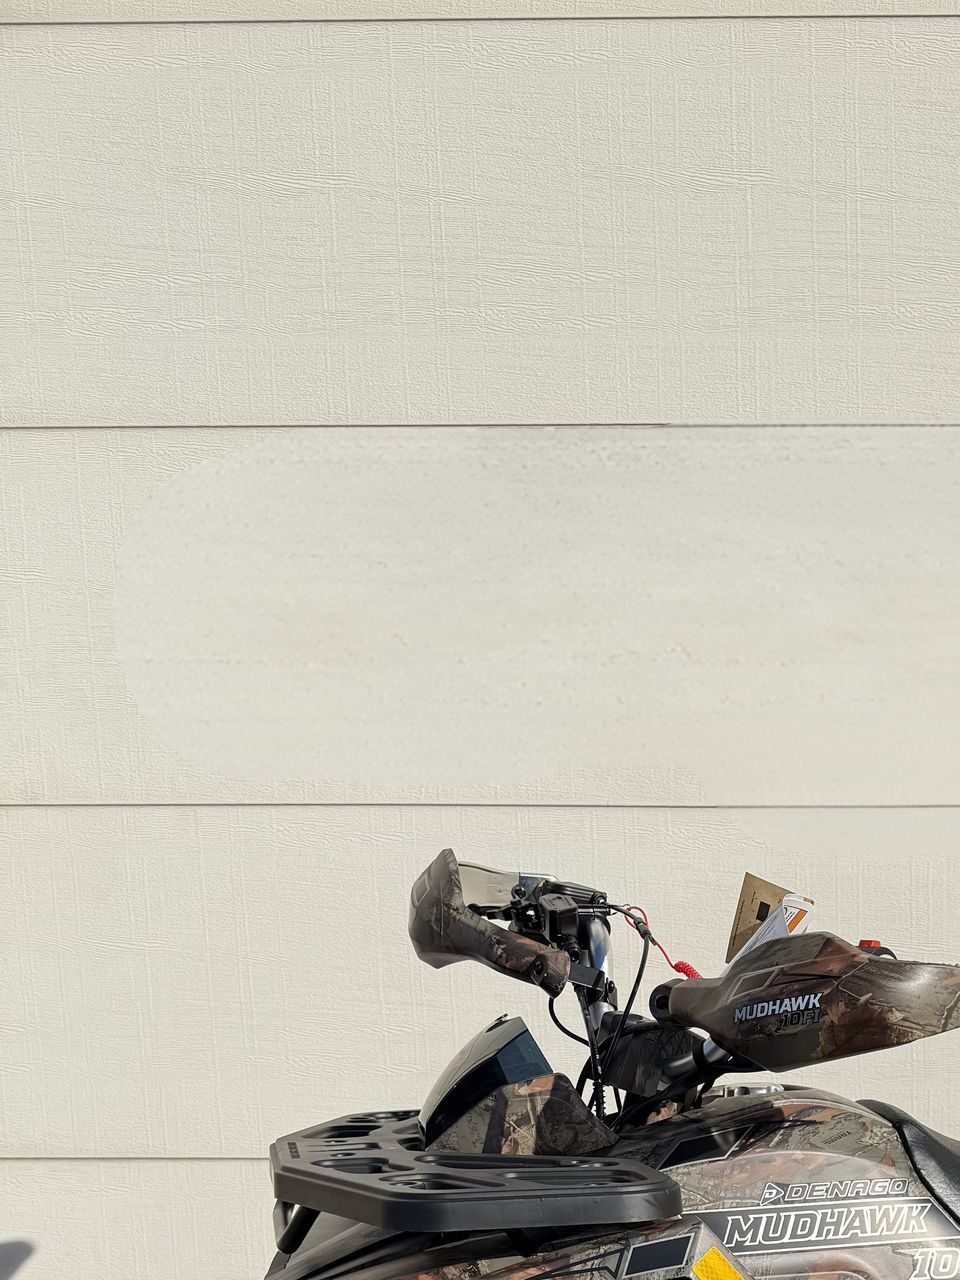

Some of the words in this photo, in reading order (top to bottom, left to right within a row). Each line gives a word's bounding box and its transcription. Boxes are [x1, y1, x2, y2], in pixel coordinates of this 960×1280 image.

[734, 992, 823, 1024] MUDHAWK
[784, 1178, 909, 1202] DENAGO
[723, 1203, 932, 1249] MUDHAWK
